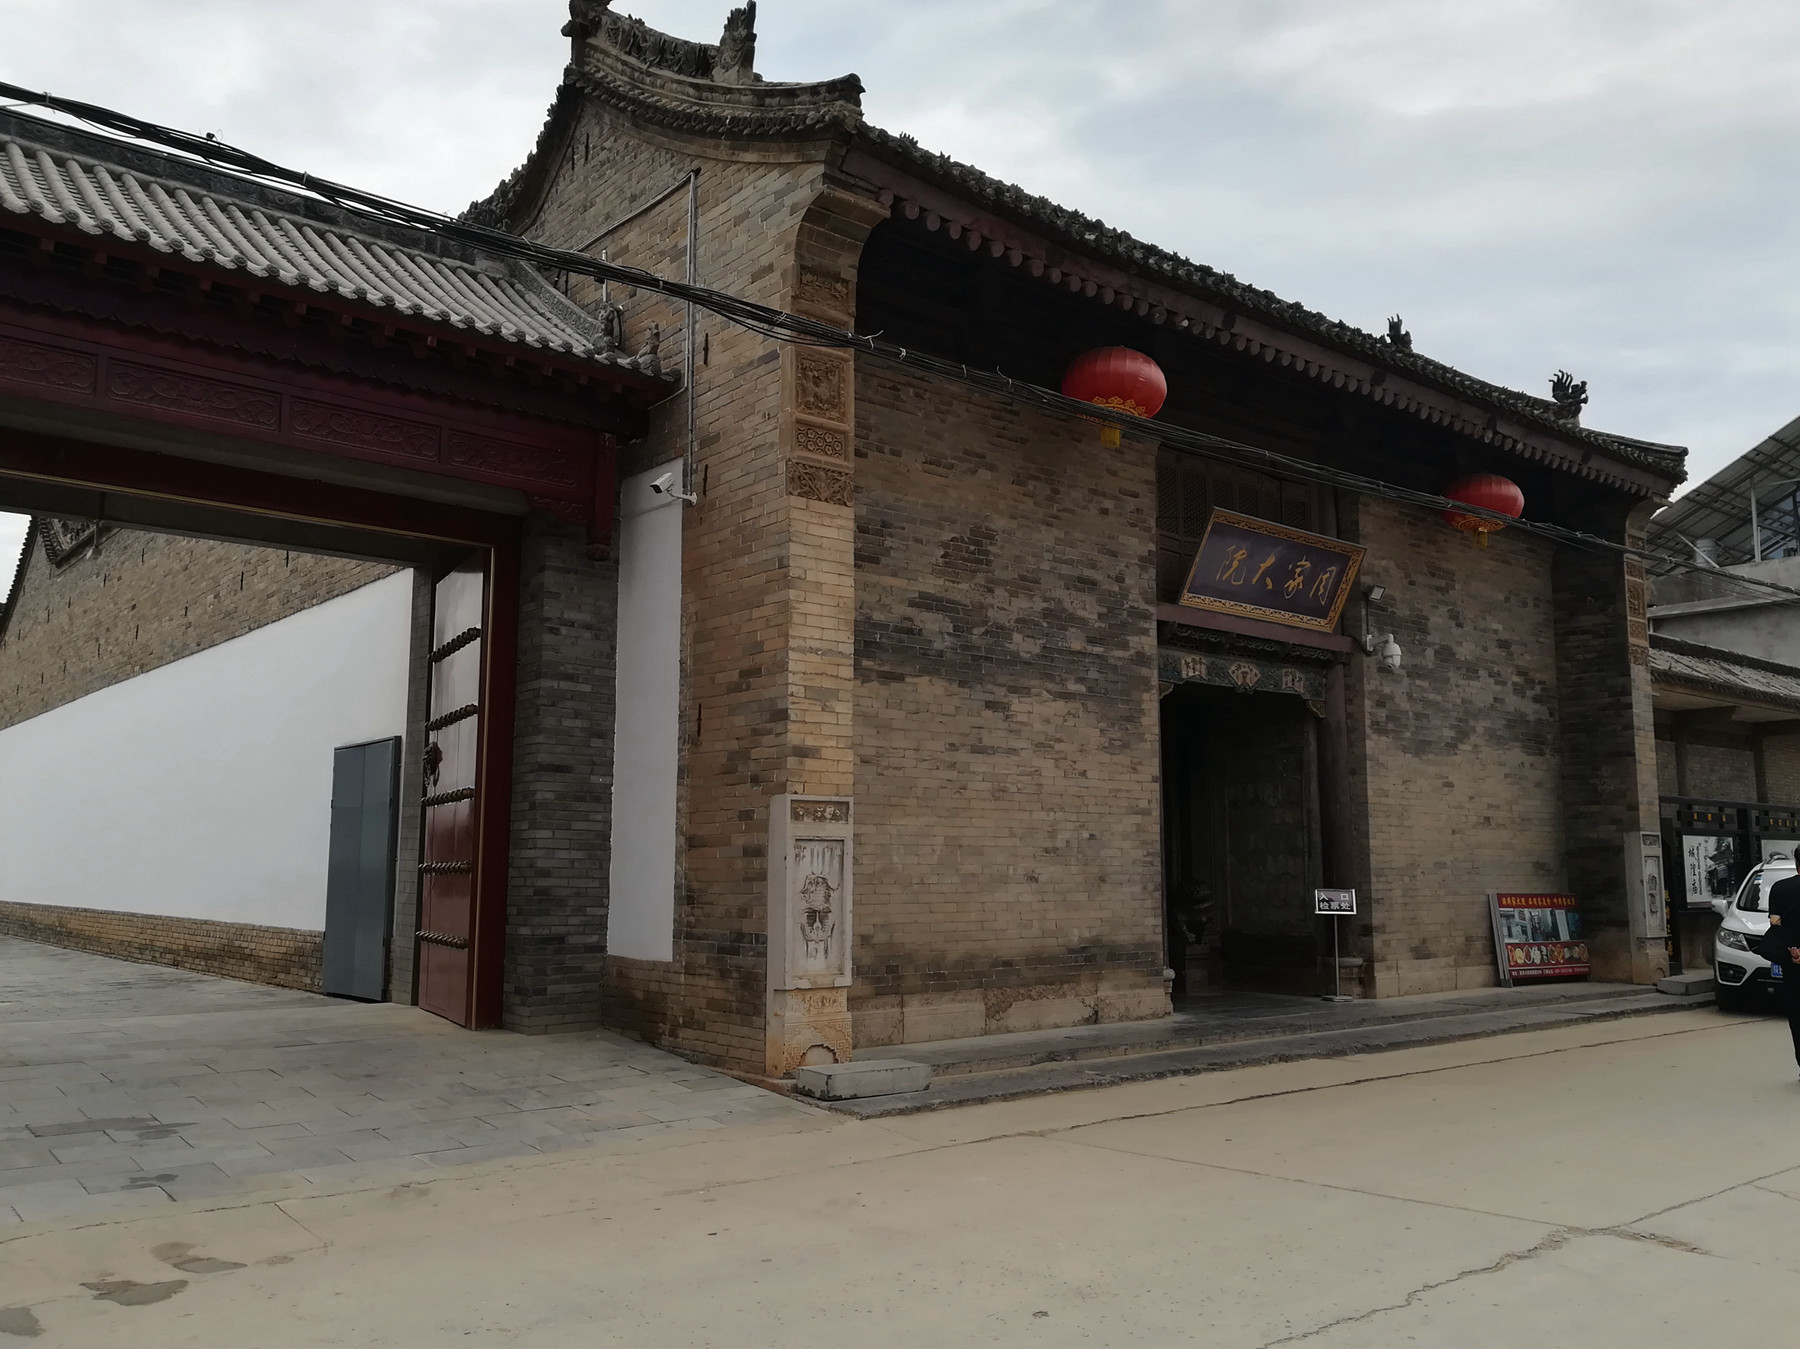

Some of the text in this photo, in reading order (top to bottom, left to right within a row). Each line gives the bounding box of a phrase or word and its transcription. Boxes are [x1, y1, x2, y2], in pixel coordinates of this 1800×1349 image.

[1319, 892, 1349, 901] 入口
[1319, 901, 1351, 910] 检票处
